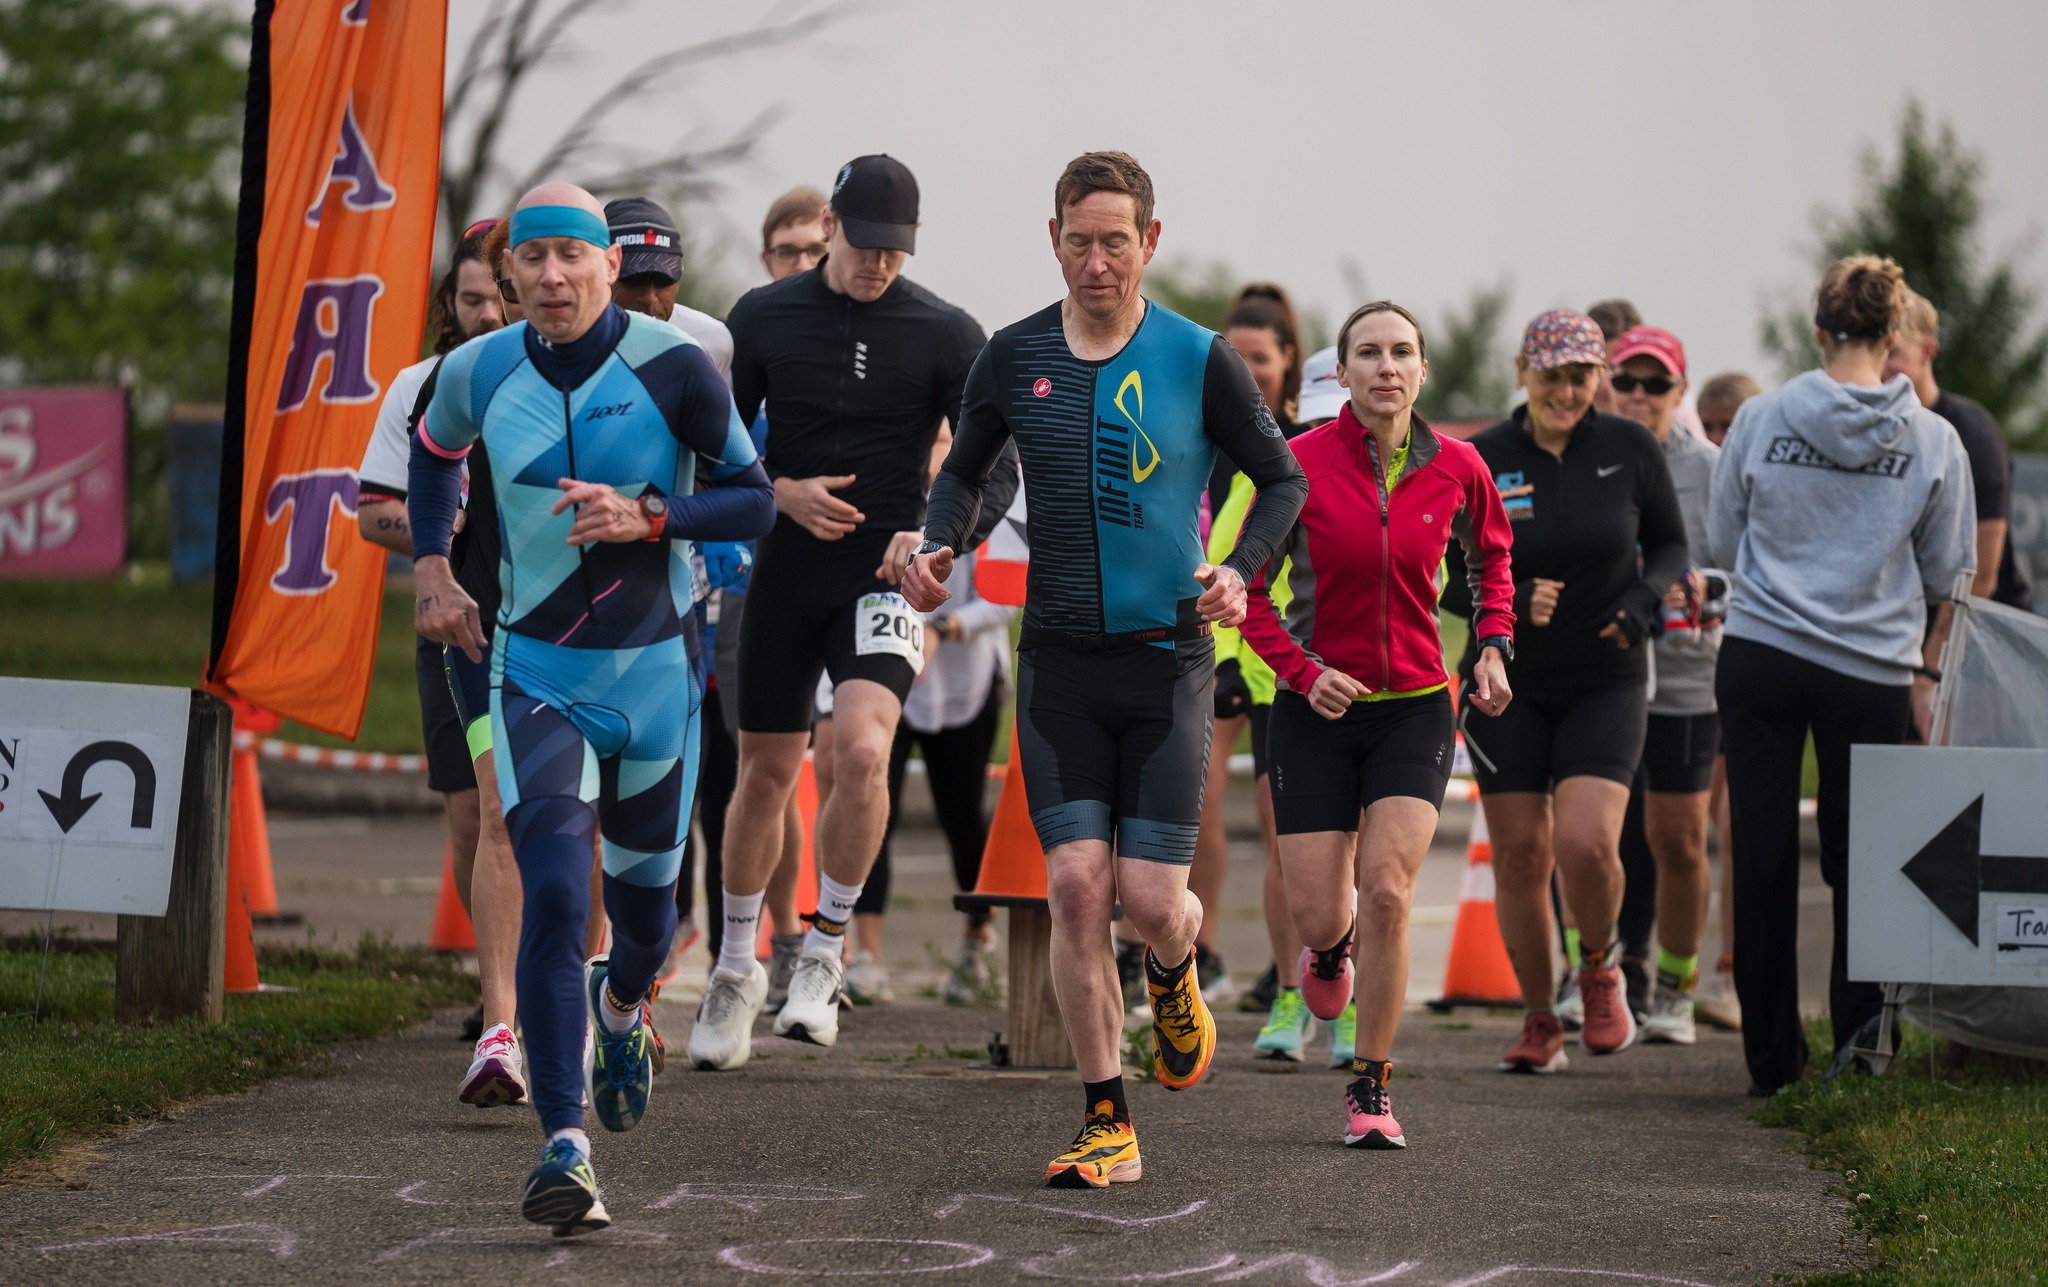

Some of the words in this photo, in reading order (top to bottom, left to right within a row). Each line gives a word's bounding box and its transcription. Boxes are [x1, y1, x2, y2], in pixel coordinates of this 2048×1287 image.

[615, 229, 671, 248] IRONMAN
[853, 341, 868, 379] MAAP
[1096, 415, 1131, 528] INFINIT
[1133, 502, 1144, 529] TEAM
[1135, 629, 1167, 640] HYBRID
[2006, 908, 2048, 938] Tra
